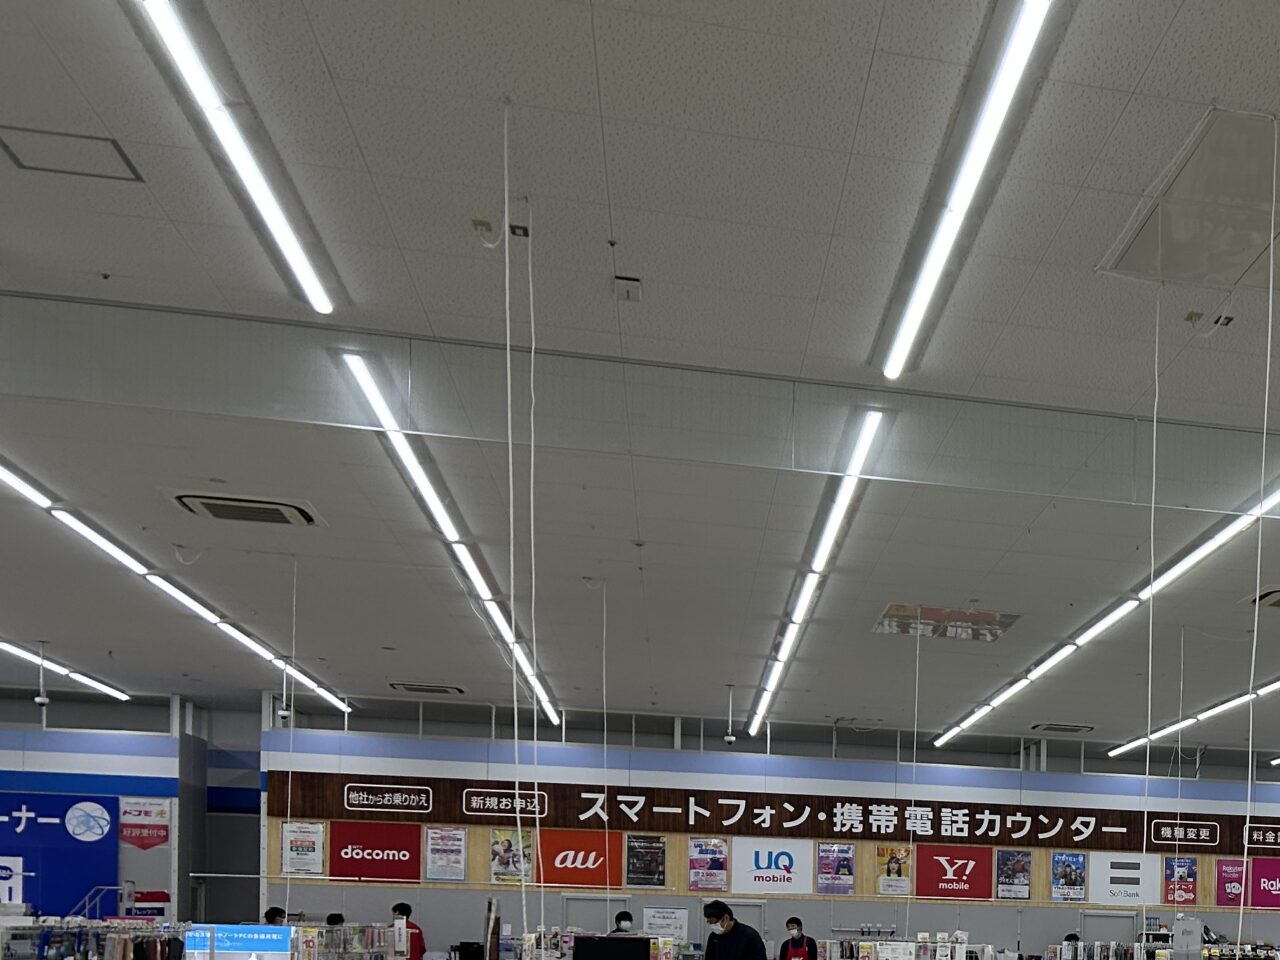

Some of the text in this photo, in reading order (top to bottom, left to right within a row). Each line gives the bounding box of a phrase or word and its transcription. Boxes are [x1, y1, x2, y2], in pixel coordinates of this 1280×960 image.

[349, 790, 429, 807] 他社からお乗りかえ
[470, 795, 540, 811] 新規お申込
[578, 792, 1128, 842] スマートフォン・携帯電話カウンター
[1161, 826, 1211, 841] 機種変更
[340, 845, 411, 861] docomo
[554, 849, 605, 869] au
[753, 850, 795, 874] UQ
[933, 855, 977, 880] Y!
[753, 874, 793, 883] mobile
[938, 881, 970, 890] mobile
[1109, 889, 1141, 899] SoftBank
